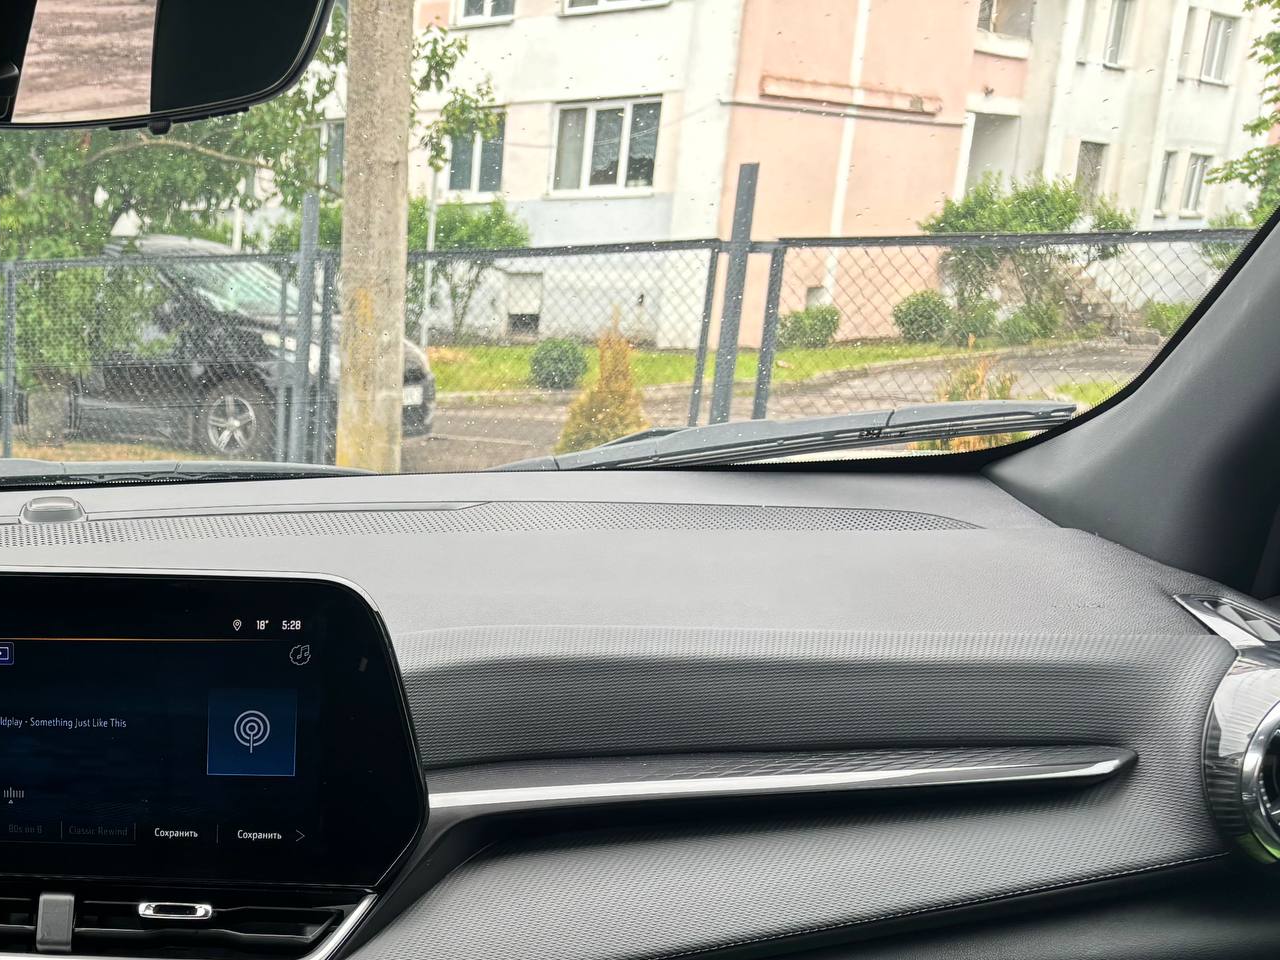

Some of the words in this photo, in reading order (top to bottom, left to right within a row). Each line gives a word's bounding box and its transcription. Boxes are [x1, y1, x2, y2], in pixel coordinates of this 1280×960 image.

[281, 620, 302, 631] 5:28
[30, 717, 73, 730] Something
[74, 718, 90, 729] Just
[92, 718, 108, 729] Like
[109, 718, 127, 729] This
[154, 827, 199, 840] Сохранить
[237, 829, 282, 841] Сохранить
